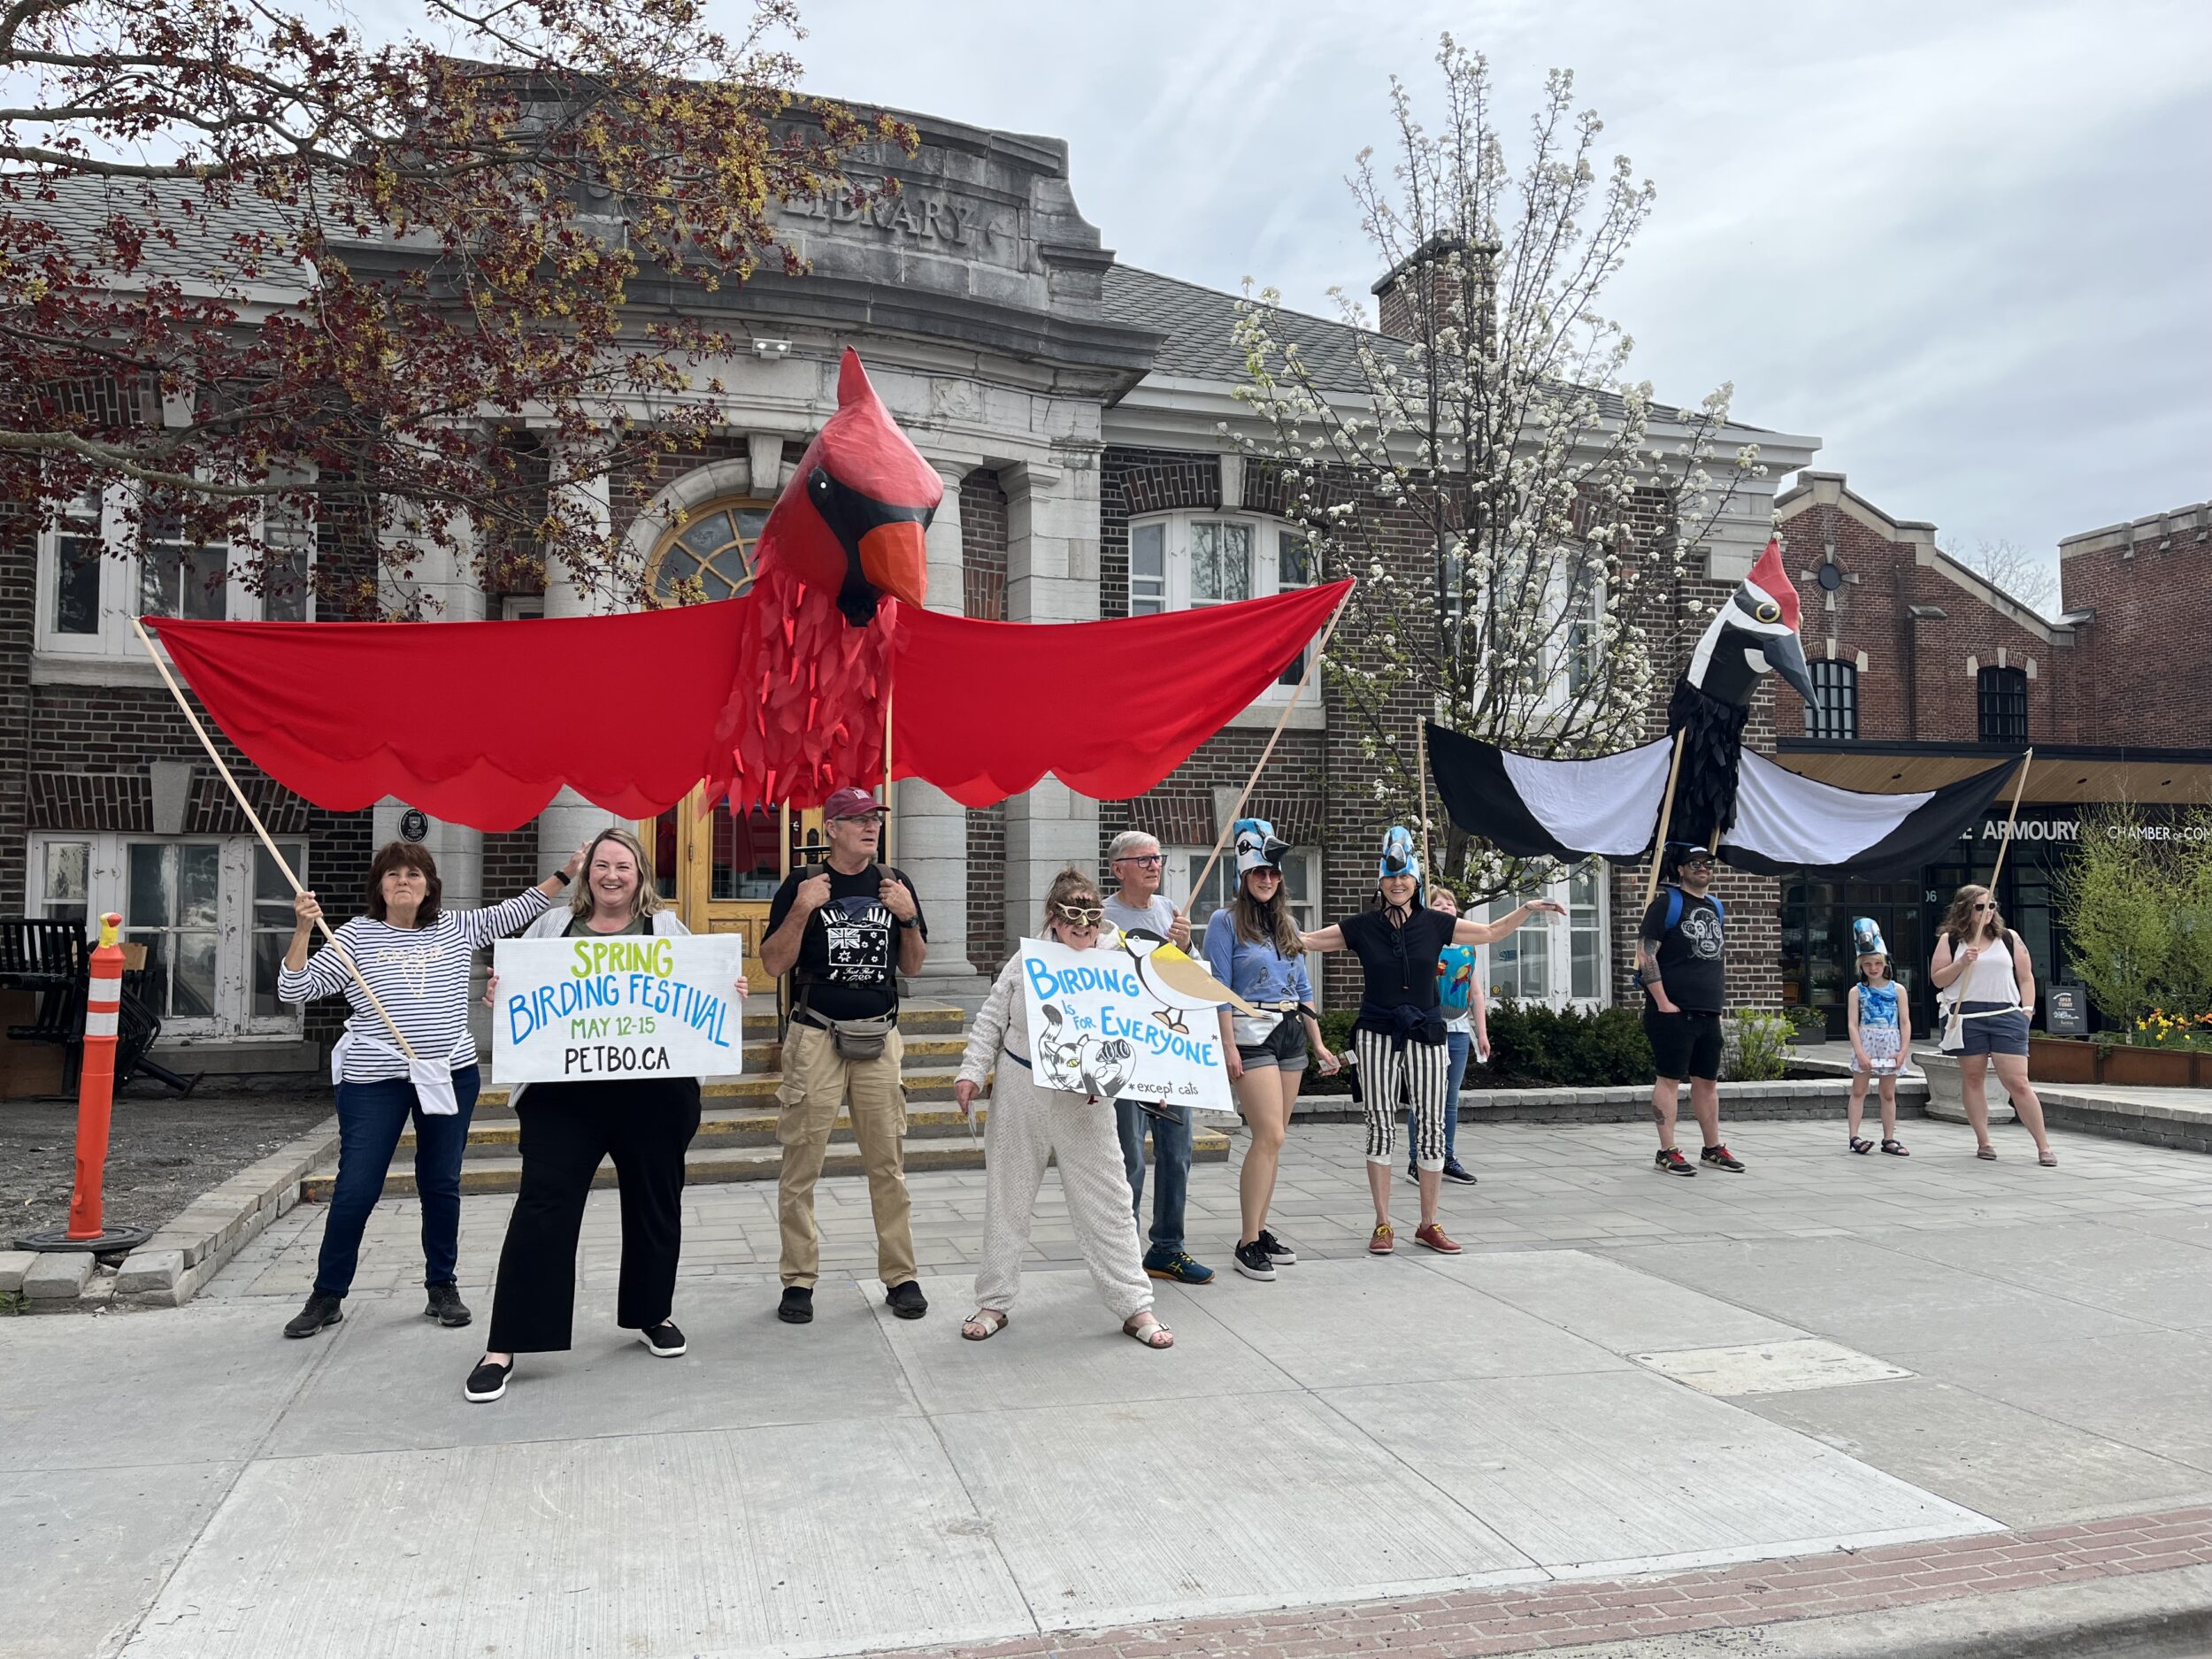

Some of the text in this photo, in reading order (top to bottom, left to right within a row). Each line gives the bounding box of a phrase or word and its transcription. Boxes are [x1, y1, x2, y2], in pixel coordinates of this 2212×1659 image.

[1982, 820, 2081, 841] ARMOURY
[2108, 826, 2171, 841] CHAMBER
[820, 907, 893, 929] AUSALIA
[571, 939, 673, 978] SPRING
[1025, 957, 1140, 1000] BIRDING
[509, 974, 730, 1048] BIRDING FESTIVAL
[571, 1017, 656, 1040] MAY 12-15
[564, 1046, 670, 1074] PETBO.CA
[1178, 1081, 1199, 1094] cats
